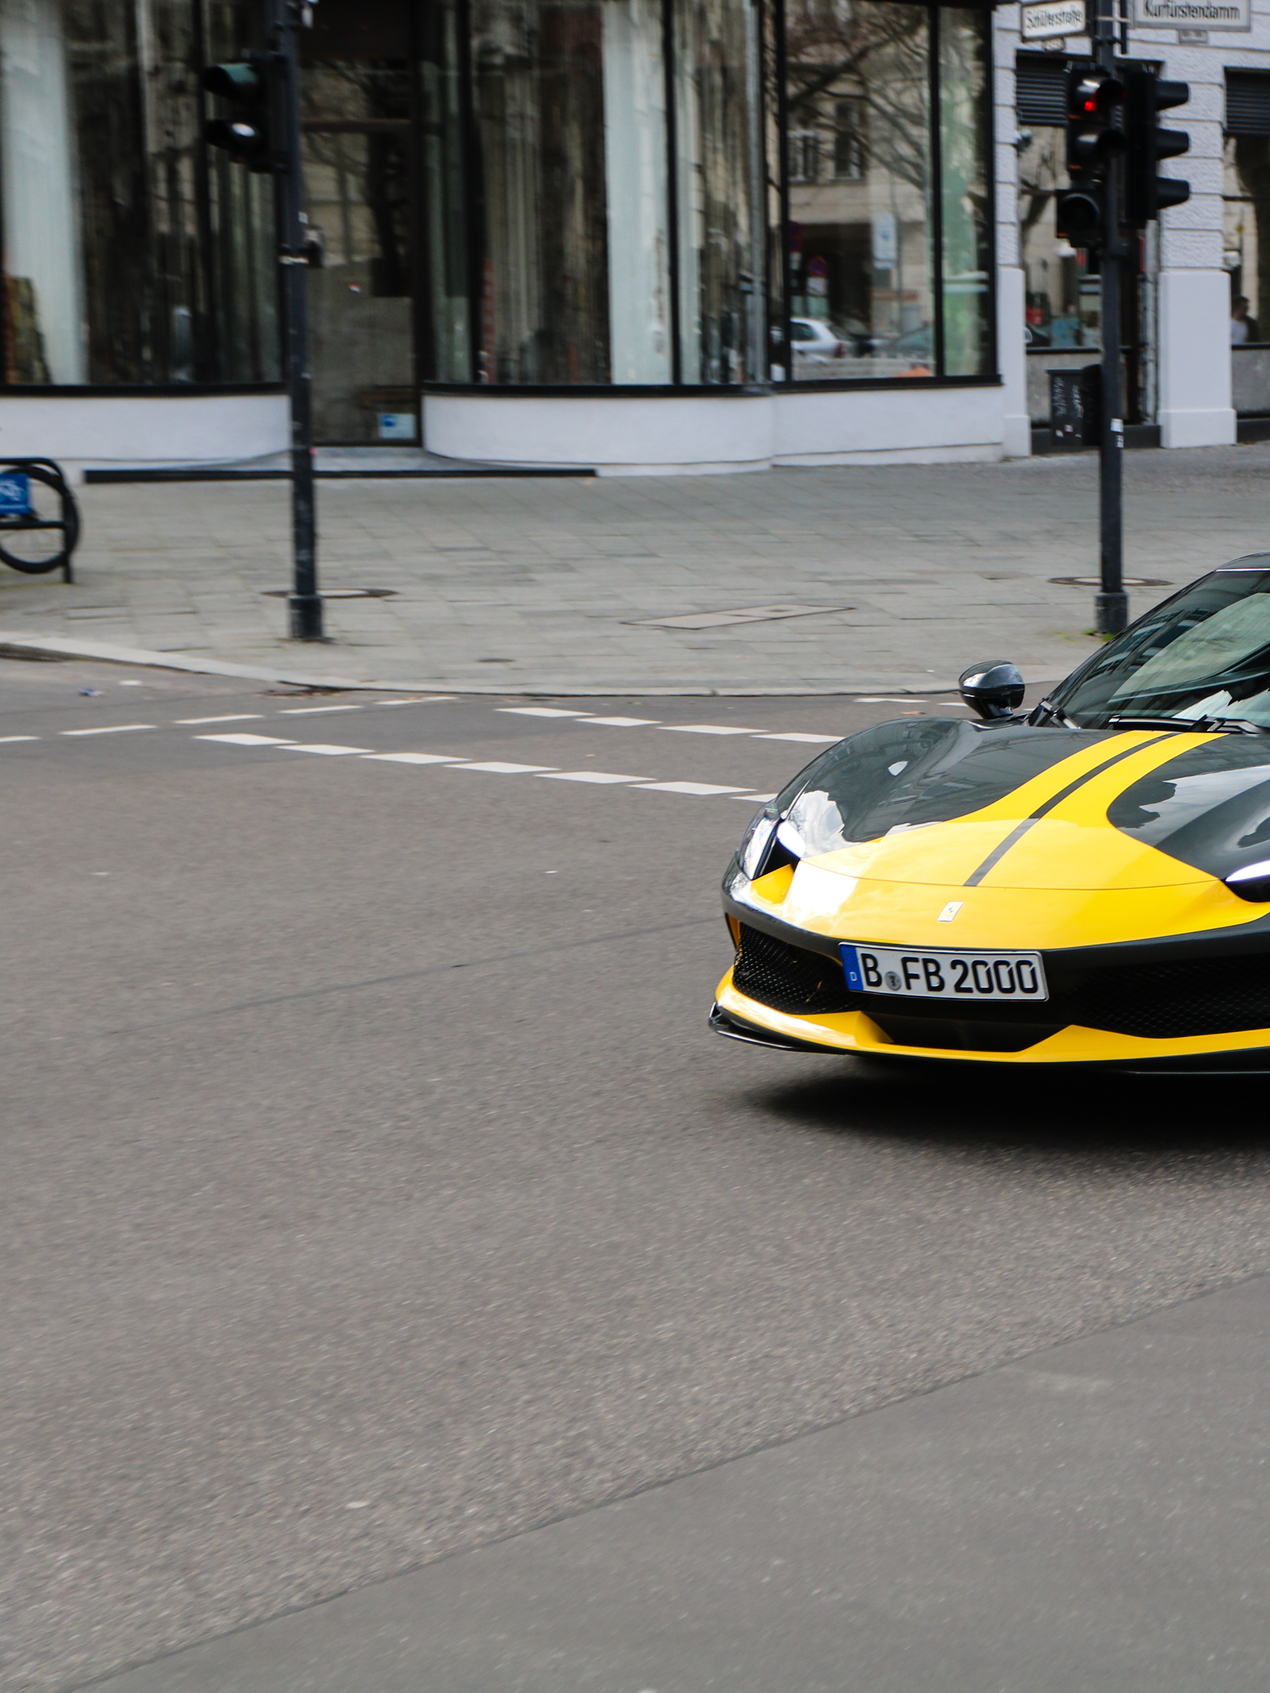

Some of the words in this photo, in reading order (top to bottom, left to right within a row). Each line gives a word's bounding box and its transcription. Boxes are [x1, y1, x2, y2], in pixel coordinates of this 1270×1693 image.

[1144, 0, 1241, 19] Kurfürstendamm
[860, 953, 883, 988] B
[901, 956, 945, 993] FB
[950, 959, 1039, 995] 2000
